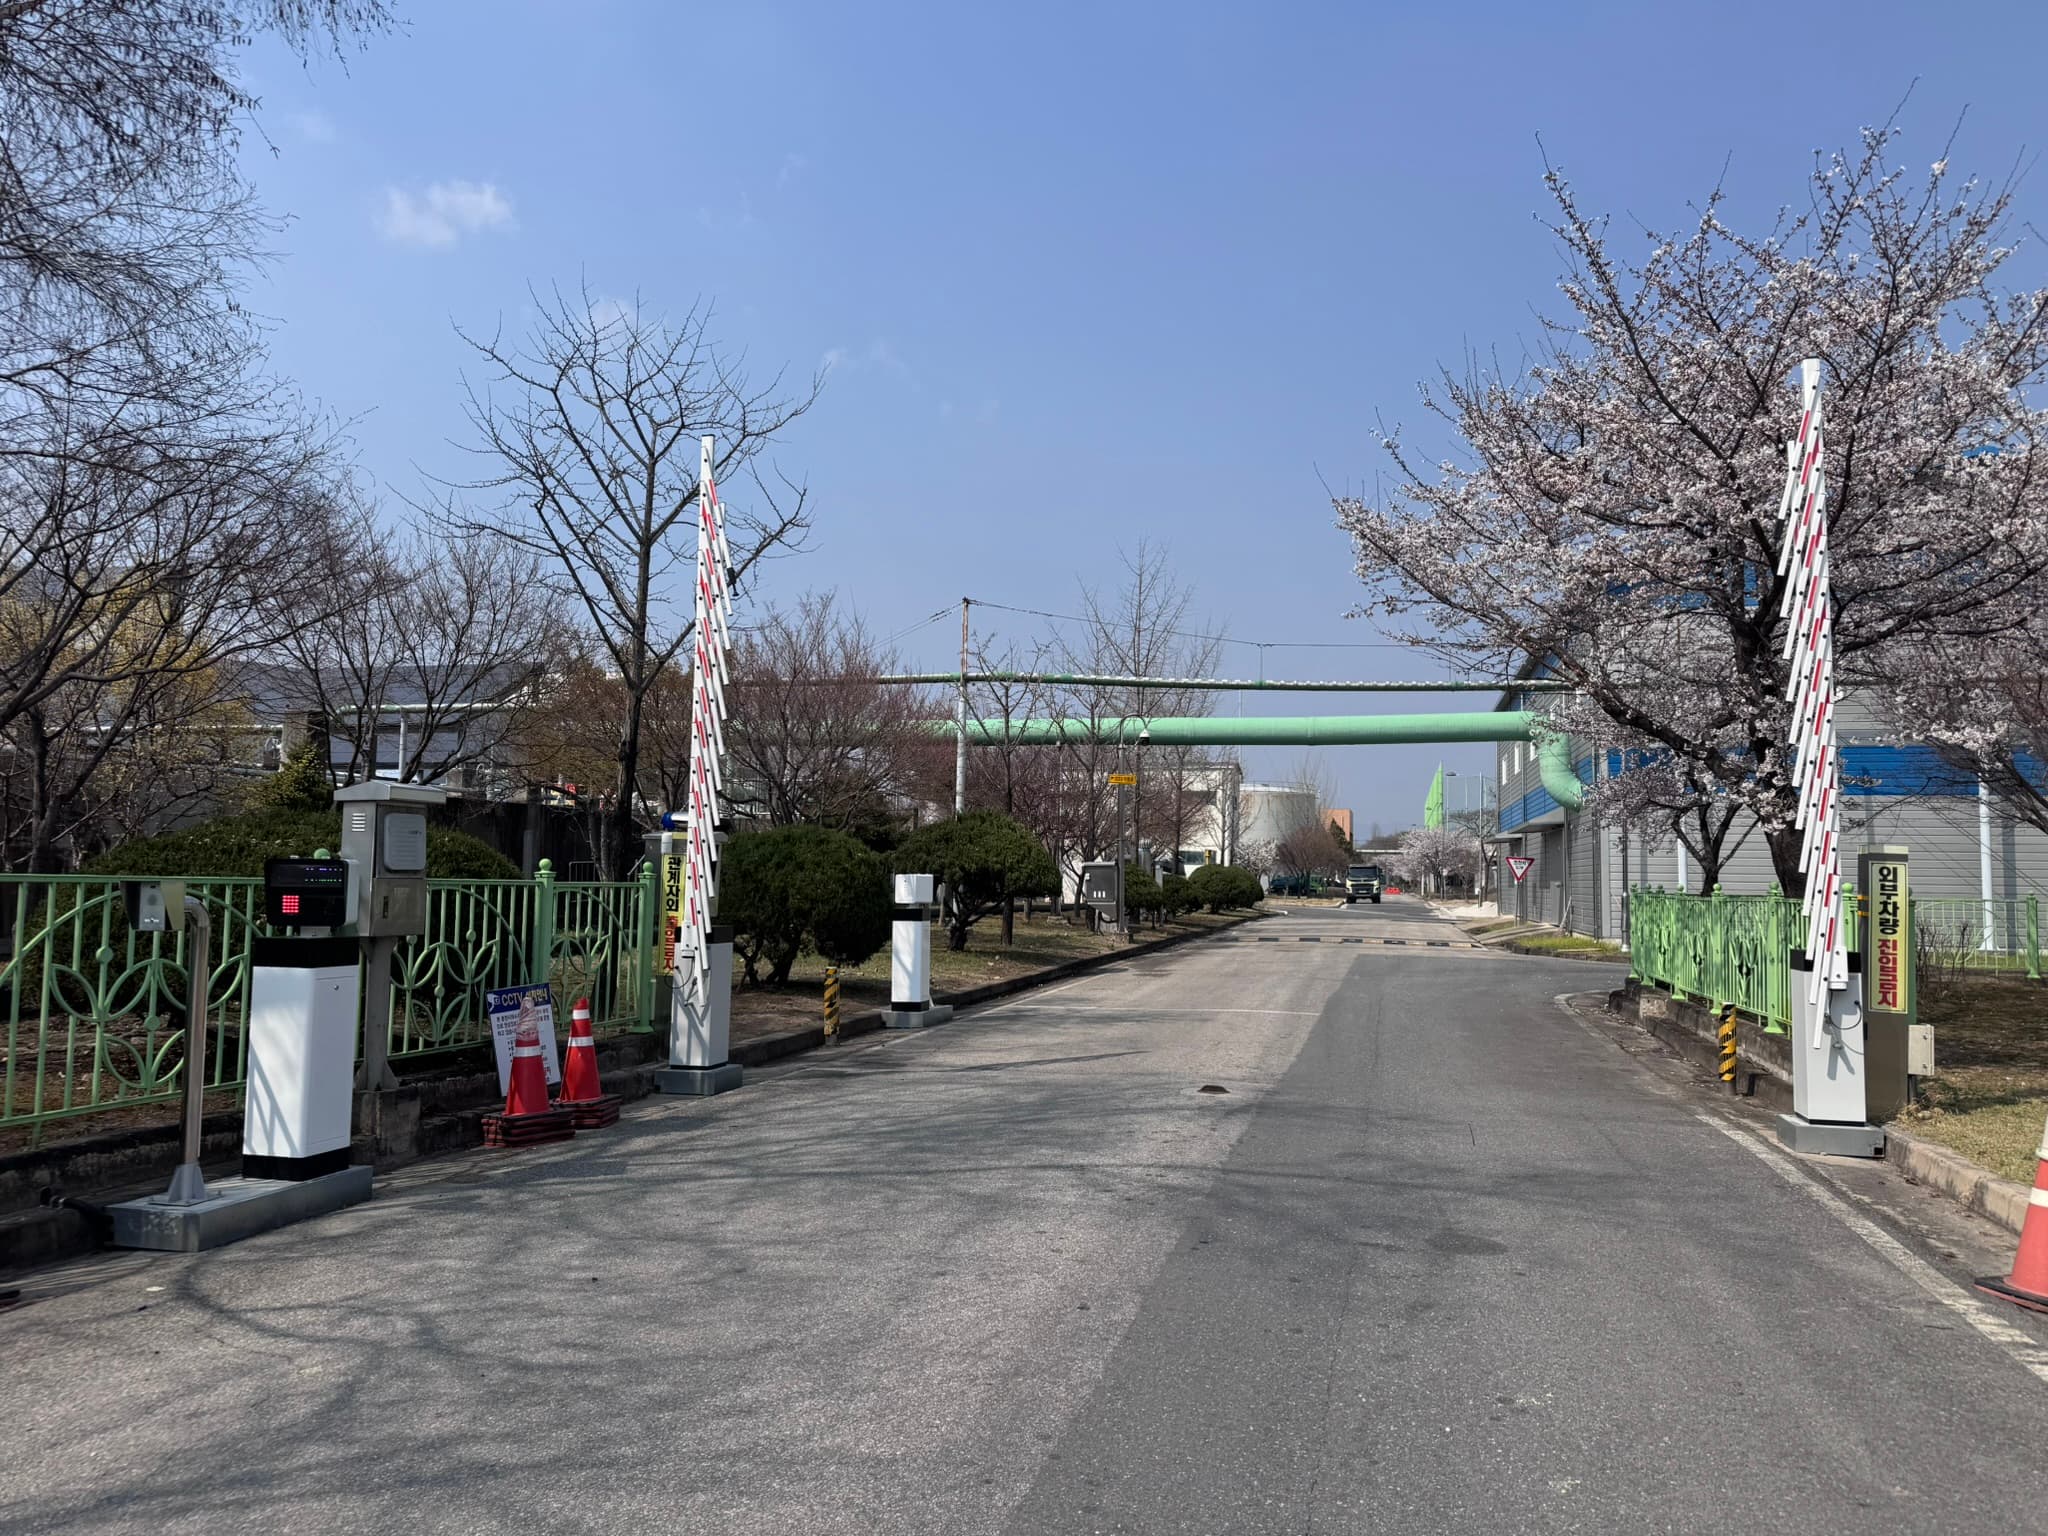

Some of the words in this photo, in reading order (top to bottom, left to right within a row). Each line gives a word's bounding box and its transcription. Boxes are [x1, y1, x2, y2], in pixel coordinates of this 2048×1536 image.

[666, 857, 682, 912] 관계자외
[1878, 866, 1899, 935] 외부차량
[501, 991, 523, 1007] CCTV
[1877, 939, 1898, 1008] 진입금지
